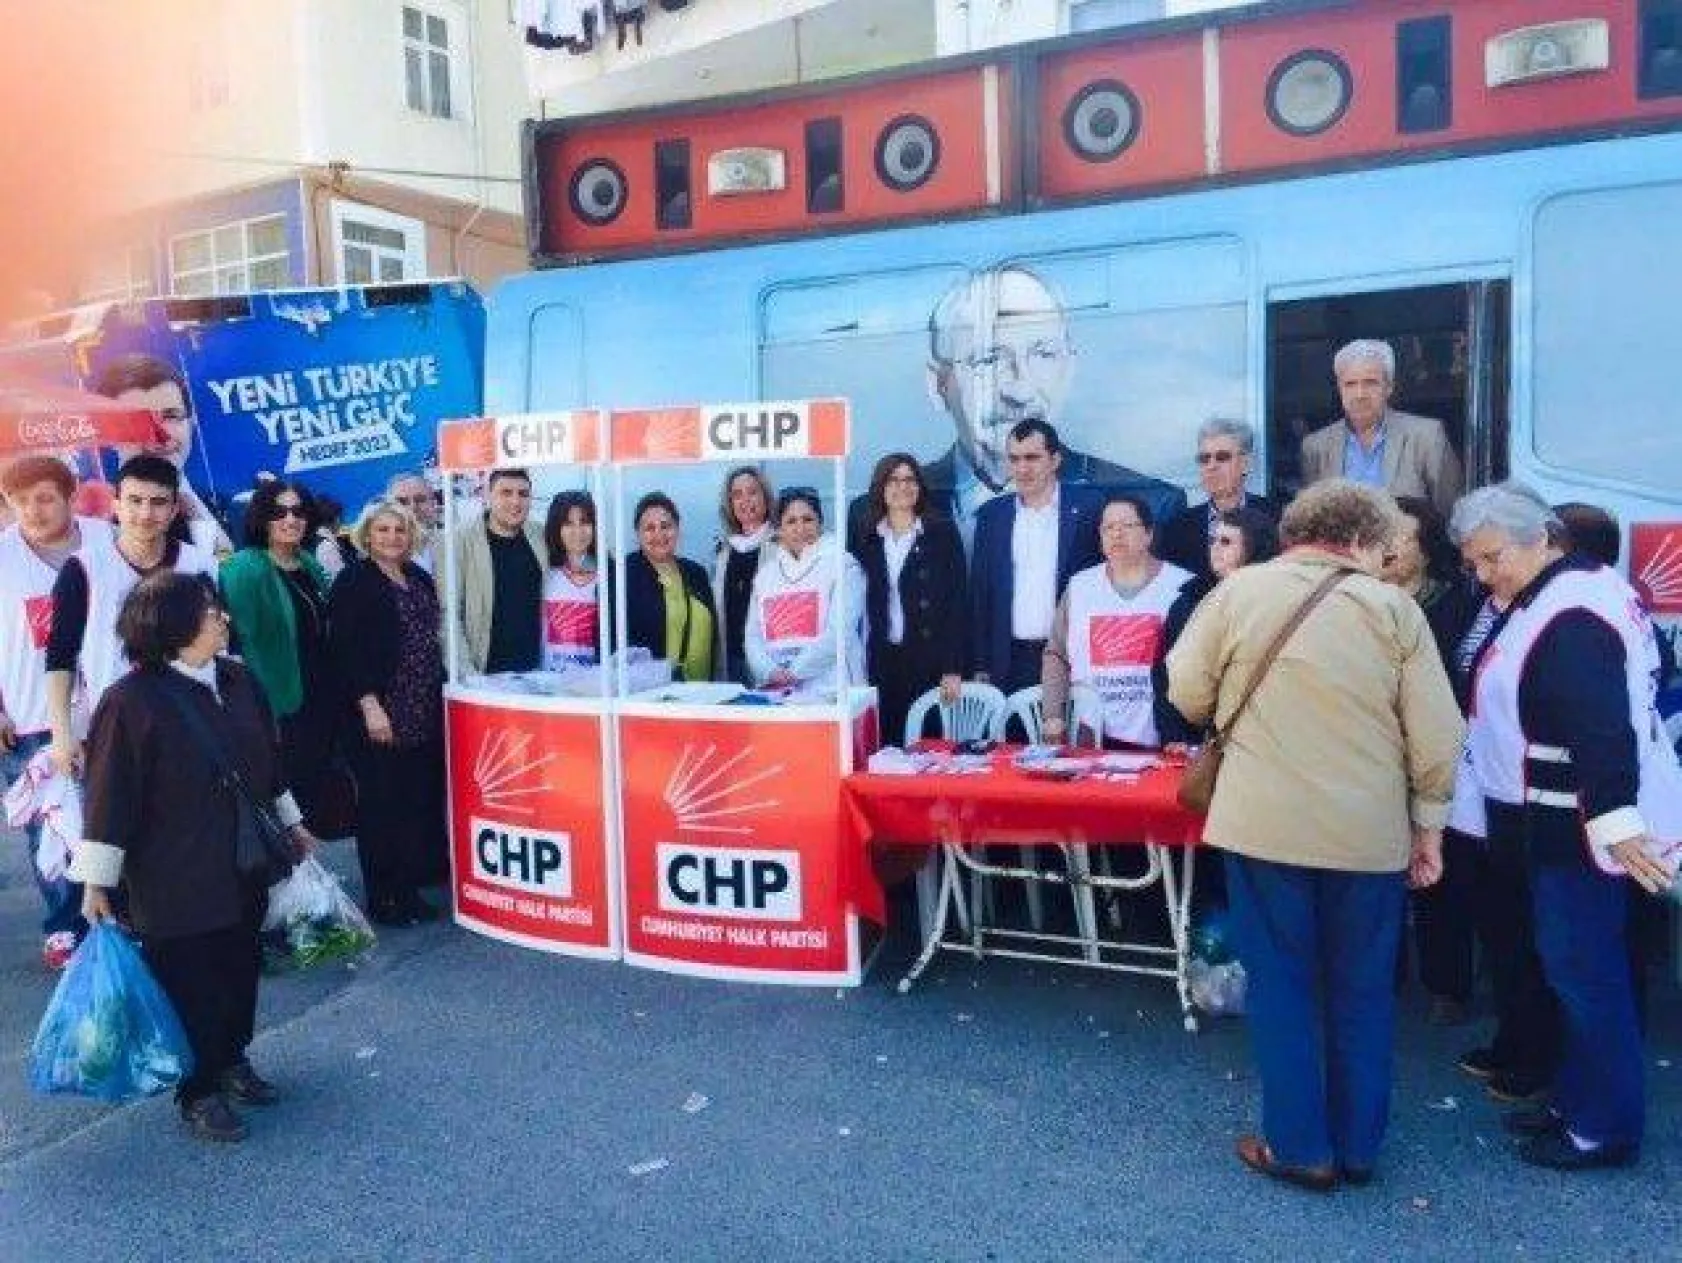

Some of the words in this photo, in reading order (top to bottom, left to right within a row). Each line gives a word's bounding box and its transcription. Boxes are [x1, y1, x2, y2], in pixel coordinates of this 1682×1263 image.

[502, 418, 567, 458] CHP
[708, 411, 801, 451] CHP
[478, 828, 562, 884] CHP
[668, 854, 788, 909] CHP
